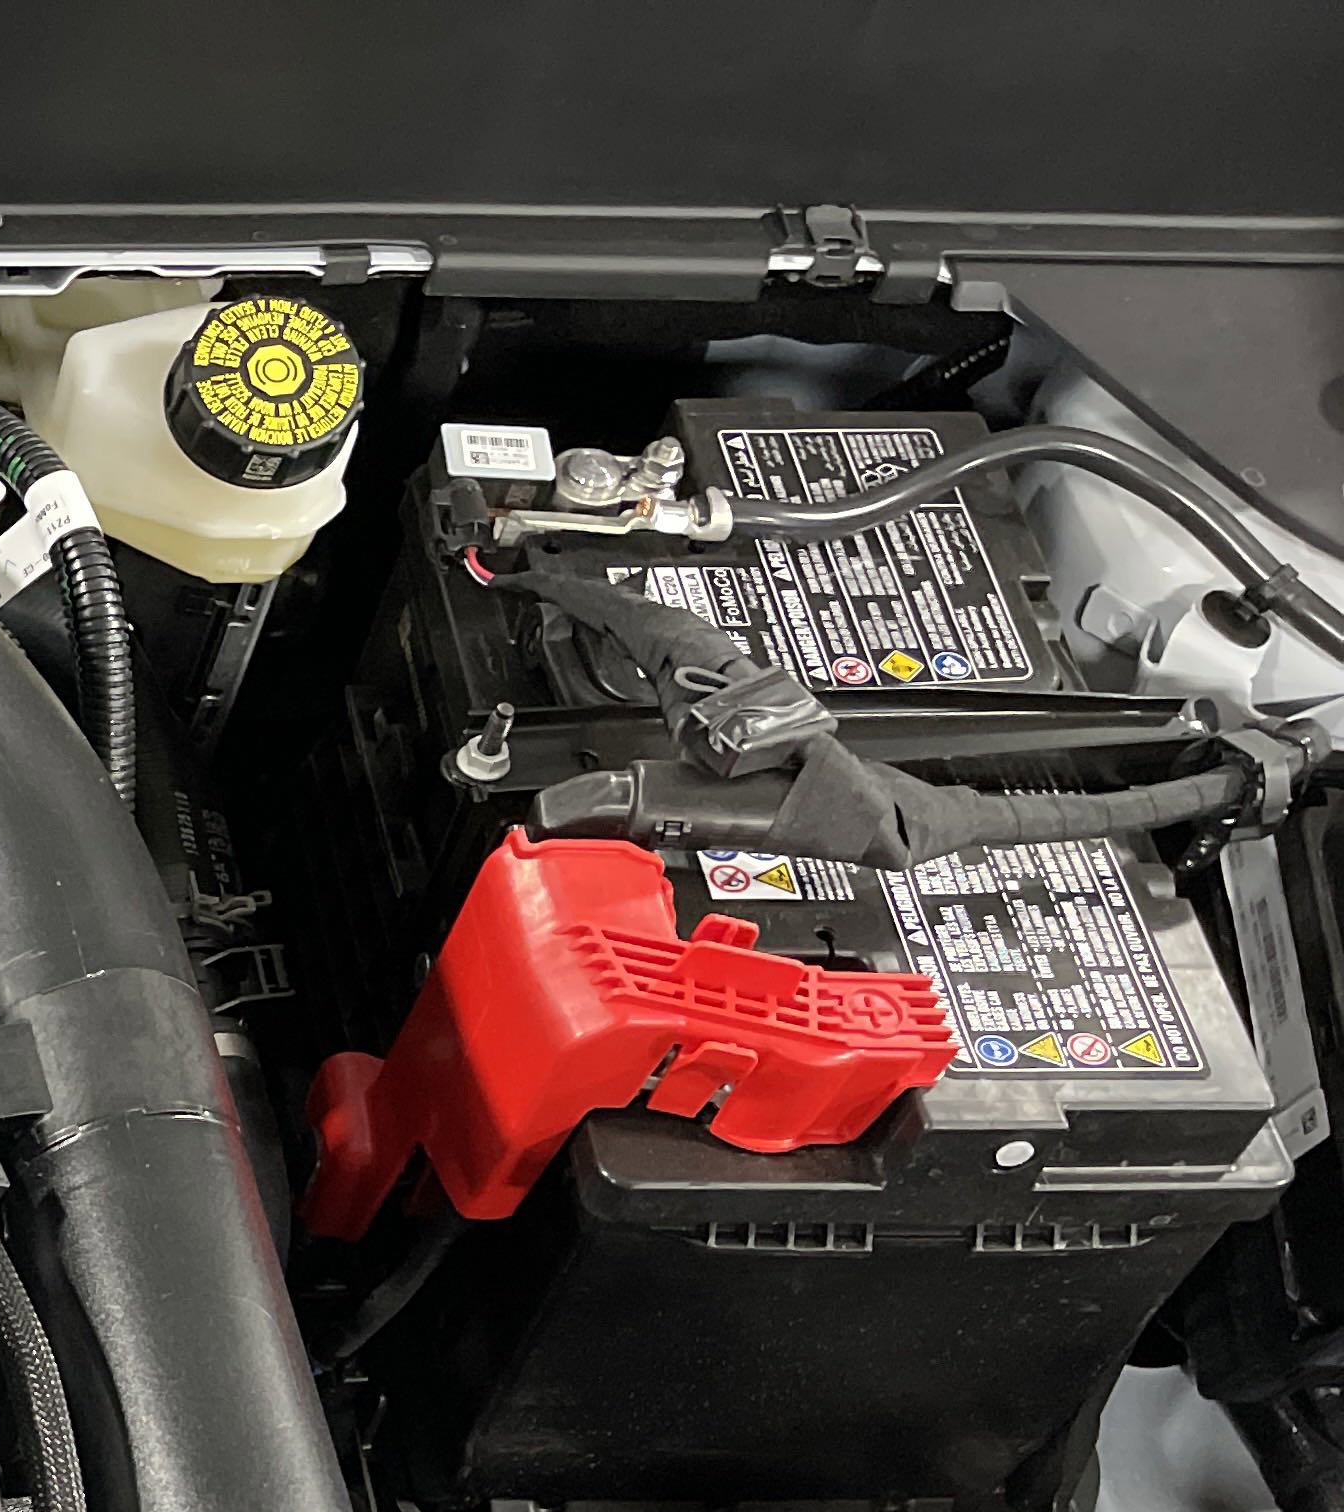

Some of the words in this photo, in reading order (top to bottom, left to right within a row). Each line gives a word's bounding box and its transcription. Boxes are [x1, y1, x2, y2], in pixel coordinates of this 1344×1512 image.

[216, 410, 249, 434] AVANT
[294, 428, 309, 443] LE
[662, 575, 679, 596] C20
[713, 567, 745, 626] FoMoCo
[1101, 878, 1119, 890] LA
[1107, 892, 1125, 906] NO
[1132, 953, 1153, 972] PAS
[1141, 974, 1159, 987] NE
[1162, 1023, 1183, 1044] NOT
[1172, 1046, 1191, 1060] DO
